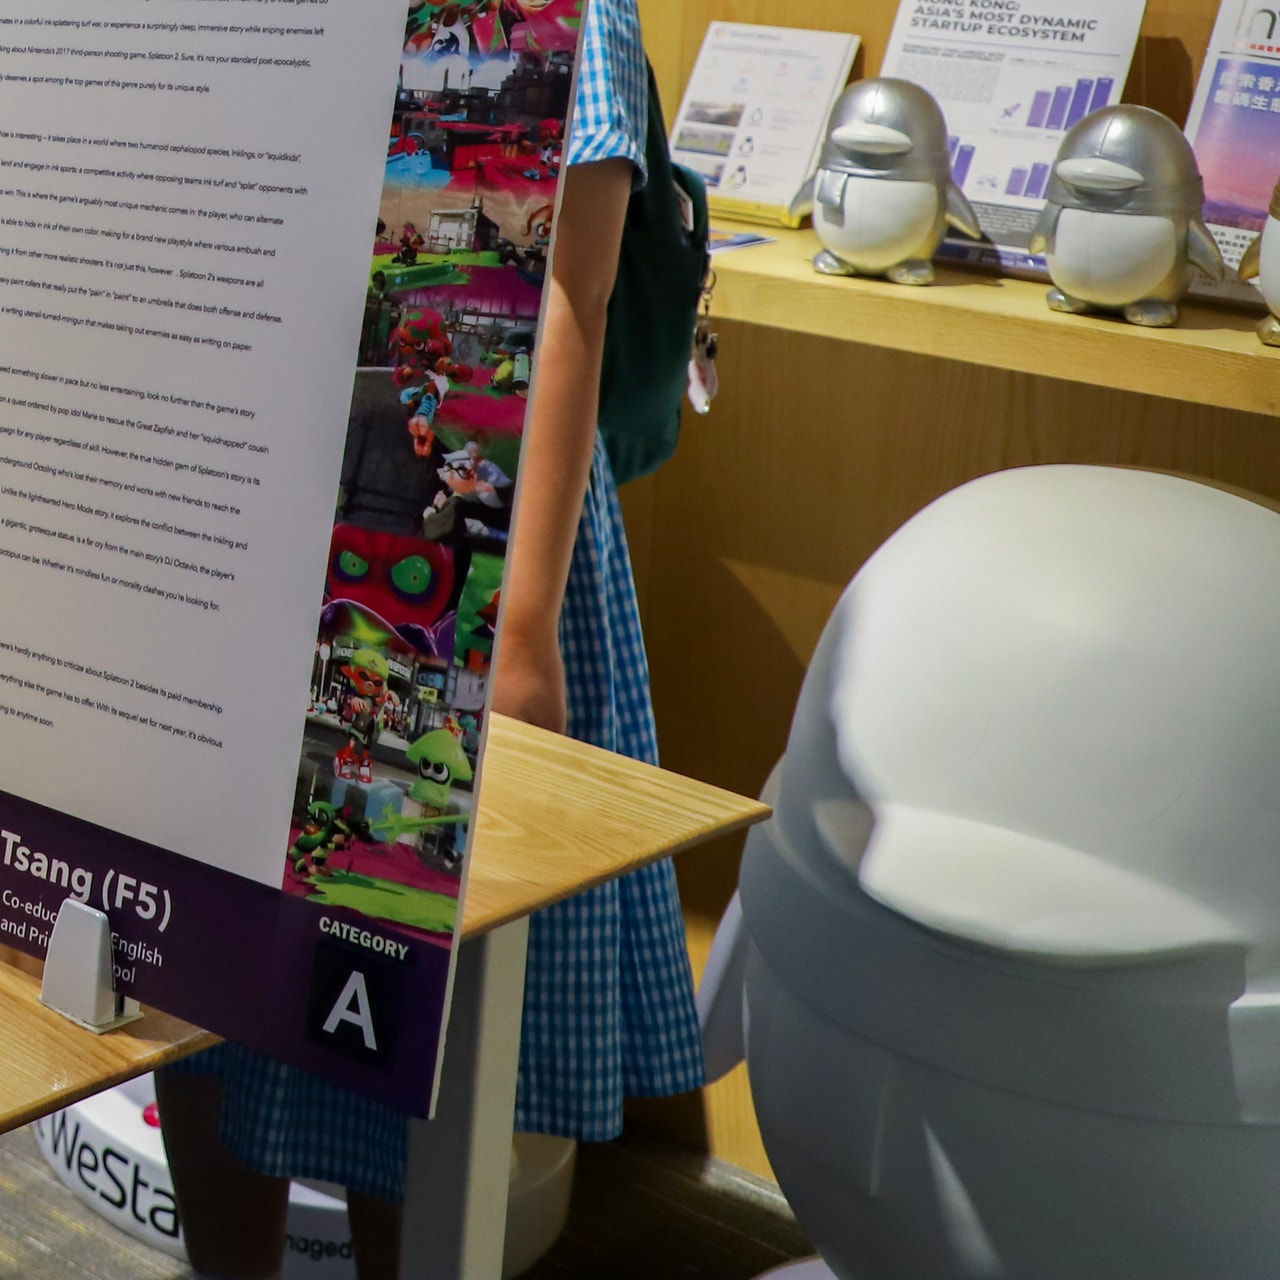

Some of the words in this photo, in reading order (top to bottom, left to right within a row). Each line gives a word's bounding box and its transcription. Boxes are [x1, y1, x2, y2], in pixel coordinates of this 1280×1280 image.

[911, 17, 983, 34] STARTUP
[987, 24, 1086, 43] ECOSYSTEM
[914, 5, 965, 19] ASIA'S
[969, 10, 1016, 24] MOST
[1019, 14, 1099, 31] DYNAMIC
[4, 74, 27, 82] deserves
[44, 77, 64, 86] among
[74, 78, 84, 86] top
[84, 79, 103, 87] games
[103, 79, 111, 87] of
[110, 79, 121, 87] this
[121, 81, 138, 89] genre
[138, 81, 157, 91] purely
[157, 81, 166, 90] for
[174, 84, 195, 92] unique
[14, 644, 31, 658] hardly
[31, 651, 56, 666] anything
[56, 657, 63, 666] to
[63, 661, 84, 672] criticize
[84, 666, 103, 677] about
[102, 670, 129, 685] Splatoon
[135, 680, 159, 695] besides
[166, 691, 182, 701] paid
[182, 696, 223, 714] membership
[9, 707, 16, 715] to
[16, 710, 38, 722] anytime
[0, 830, 94, 904] Tsang
[101, 869, 172, 934] (F5)
[0, 918, 27, 941] and
[318, 916, 409, 961] CATEGORY
[110, 931, 164, 968] English
[322, 970, 378, 1051] A
[50, 1108, 183, 1239] WeSta
[285, 1232, 354, 1262] naged
